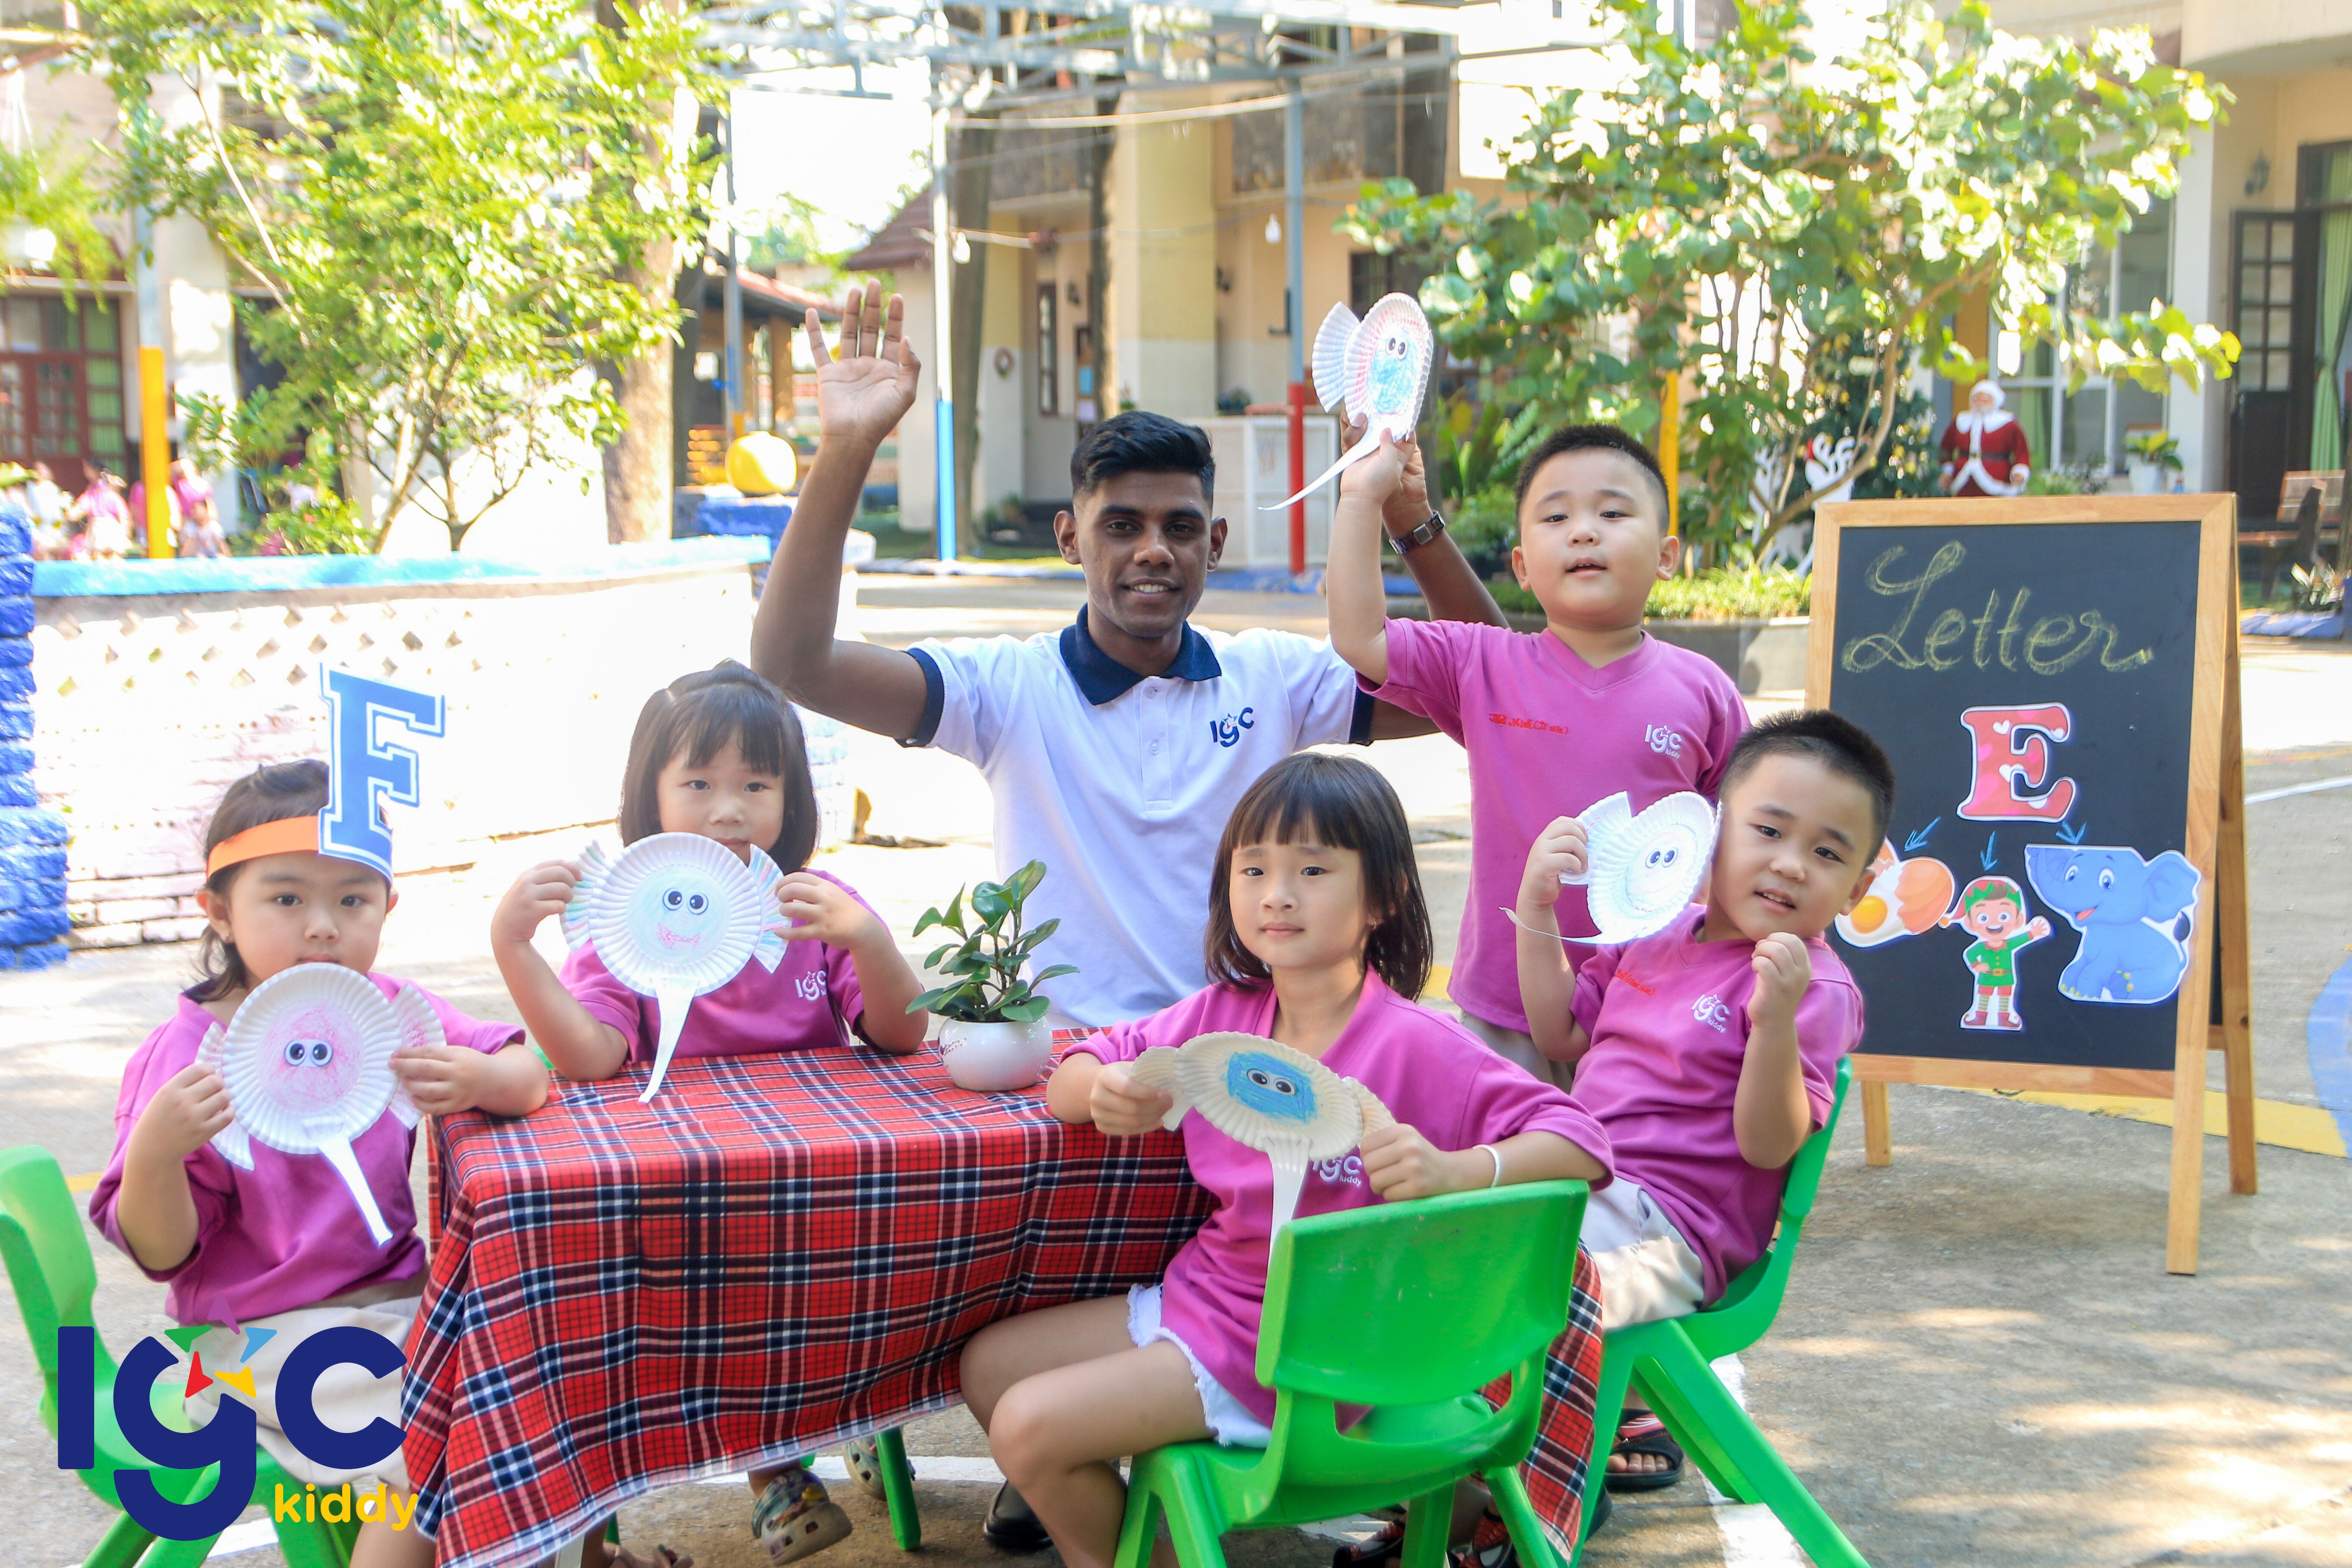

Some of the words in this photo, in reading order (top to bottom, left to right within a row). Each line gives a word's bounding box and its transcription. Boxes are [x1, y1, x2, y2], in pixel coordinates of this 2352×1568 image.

[1841, 539, 2154, 675] Letter
[318, 662, 445, 885] F
[1665, 748, 1680, 759] kiddy
[1956, 702, 2076, 822] E
[1707, 1018, 1726, 1033] kiddy
[1339, 1175, 1362, 1187] kiddy
